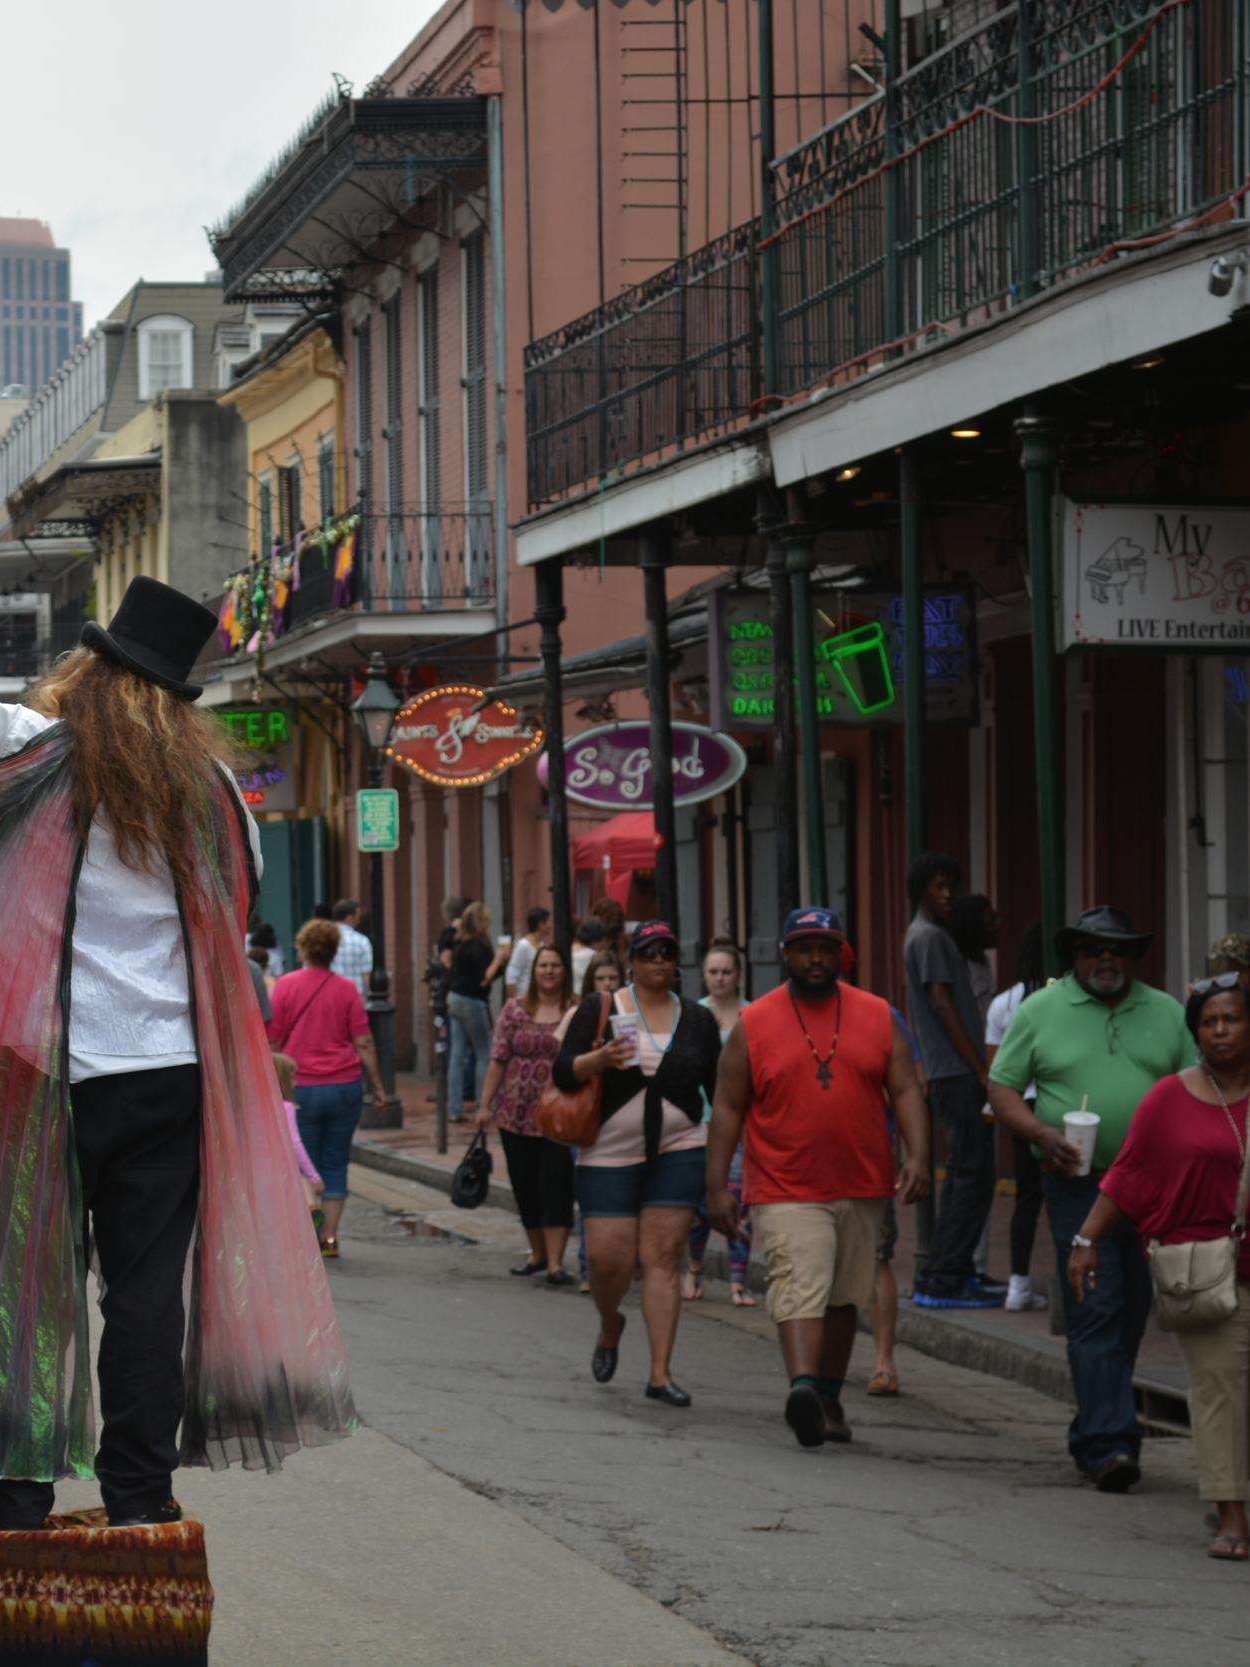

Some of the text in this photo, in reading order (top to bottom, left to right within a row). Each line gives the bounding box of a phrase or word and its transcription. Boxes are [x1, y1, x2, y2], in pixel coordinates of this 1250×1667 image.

[1154, 514, 1213, 566] My
[1118, 619, 1160, 639] LIVE
[221, 711, 288, 742] TER
[619, 736, 705, 800] God
